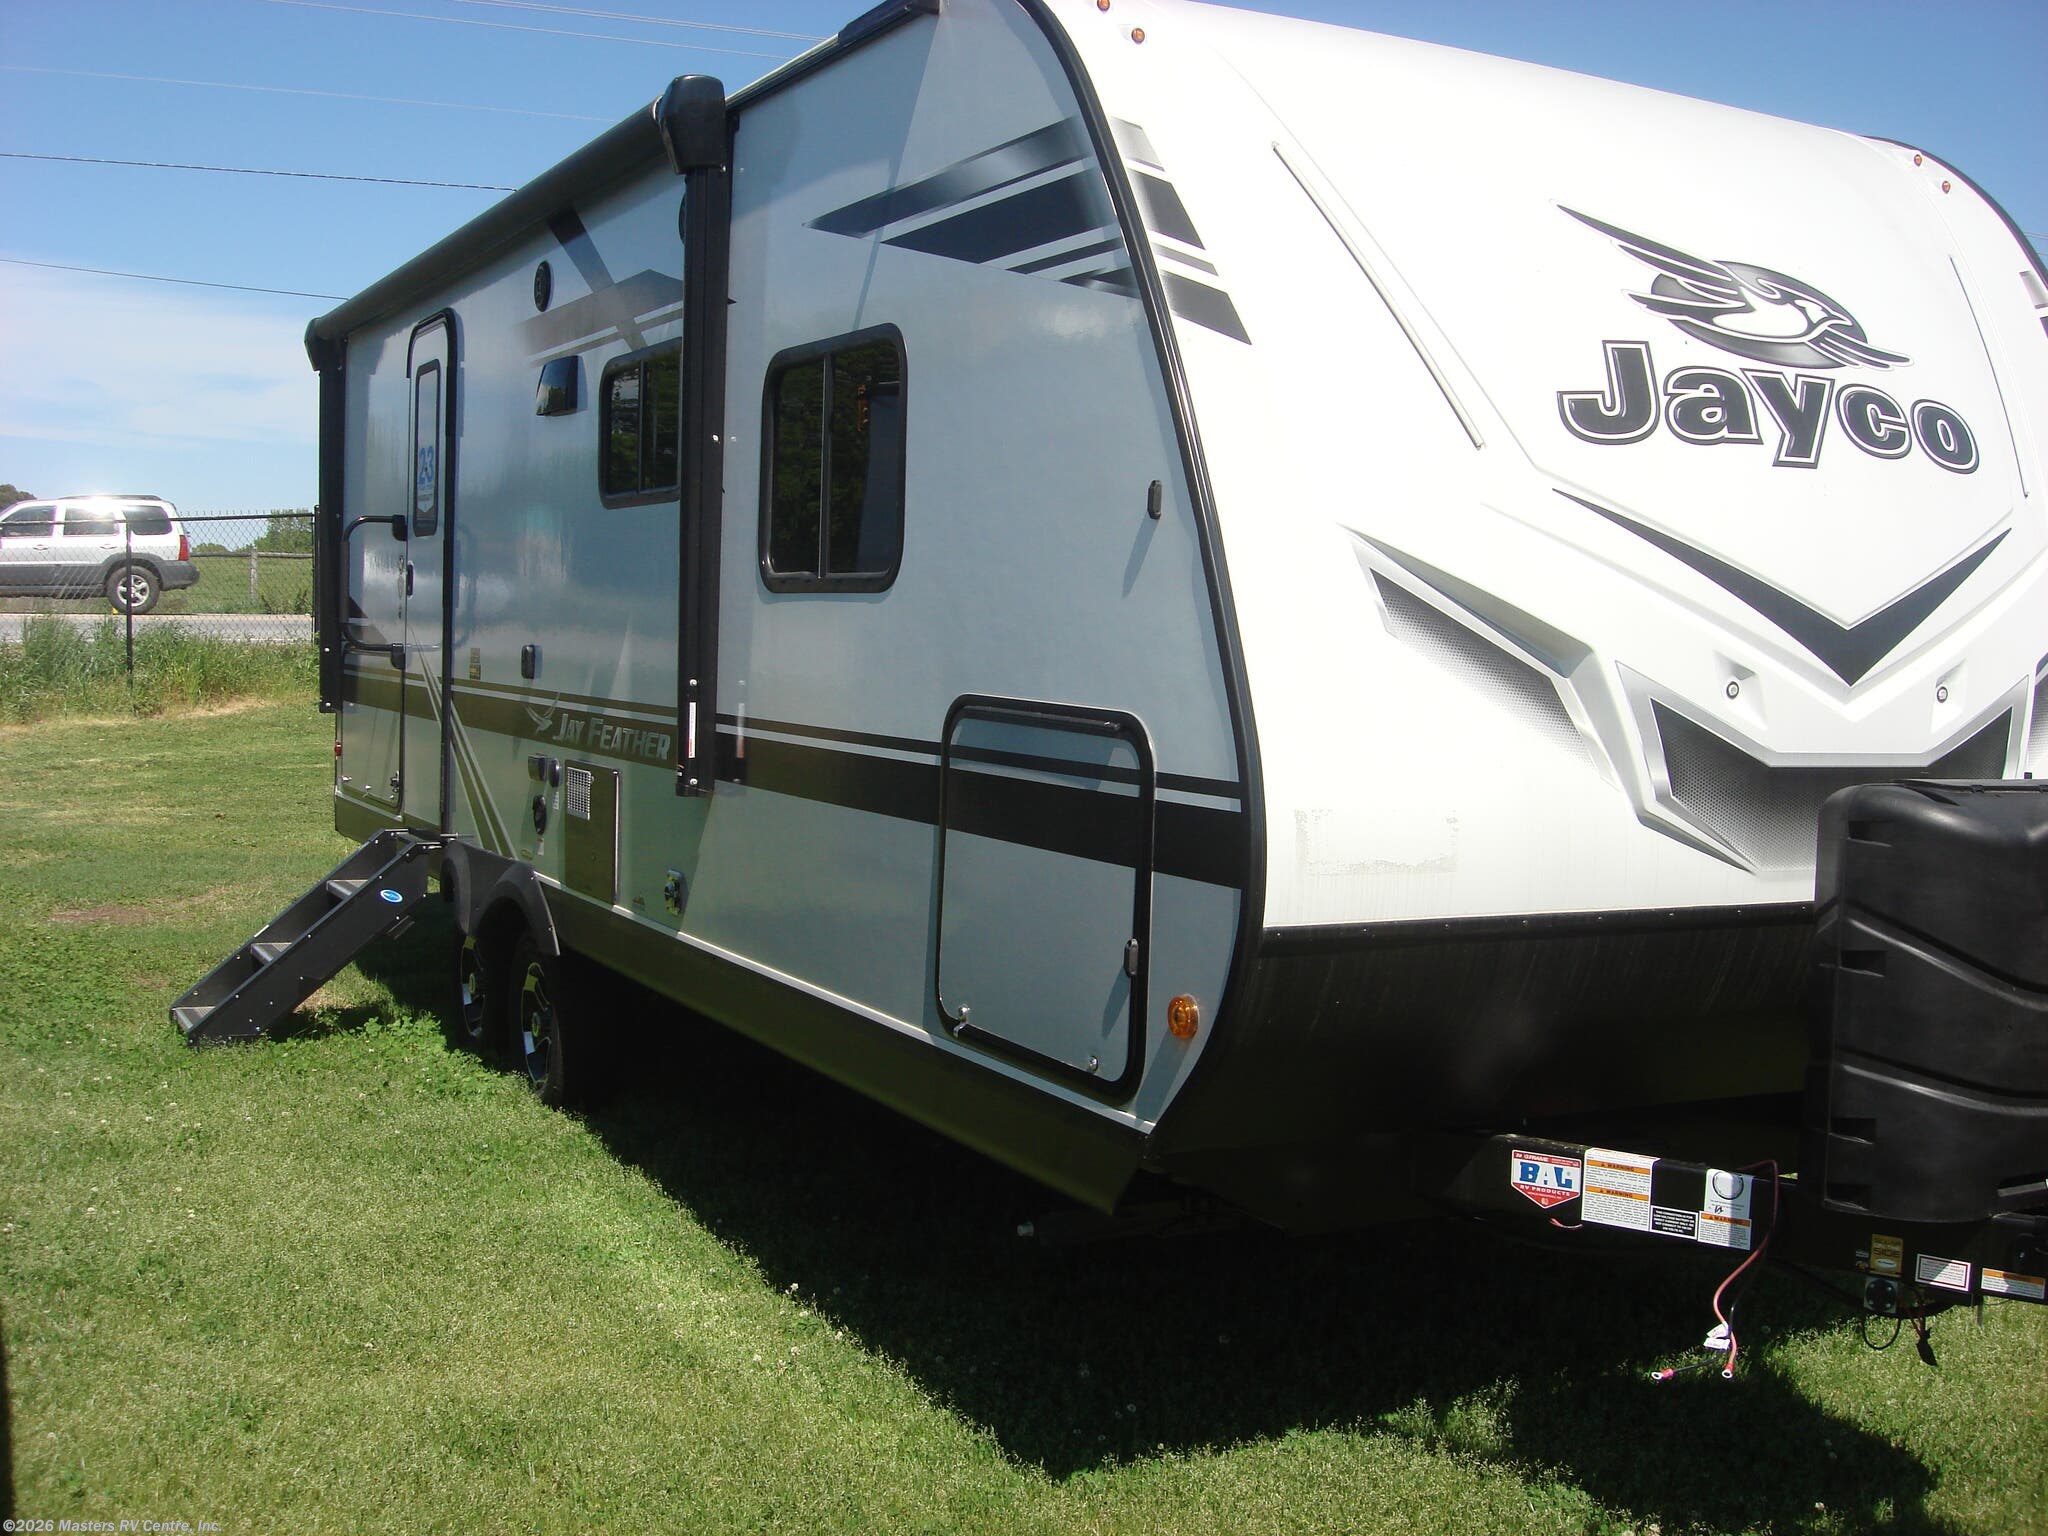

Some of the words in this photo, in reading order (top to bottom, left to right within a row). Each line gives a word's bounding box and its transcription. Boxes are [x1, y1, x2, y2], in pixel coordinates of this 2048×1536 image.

[1557, 340, 1980, 475] Jayco
[588, 716, 671, 760] FEATHER
[1519, 1161, 1573, 1189] BAL
[1531, 1187, 1571, 1197] PRODUCTS
